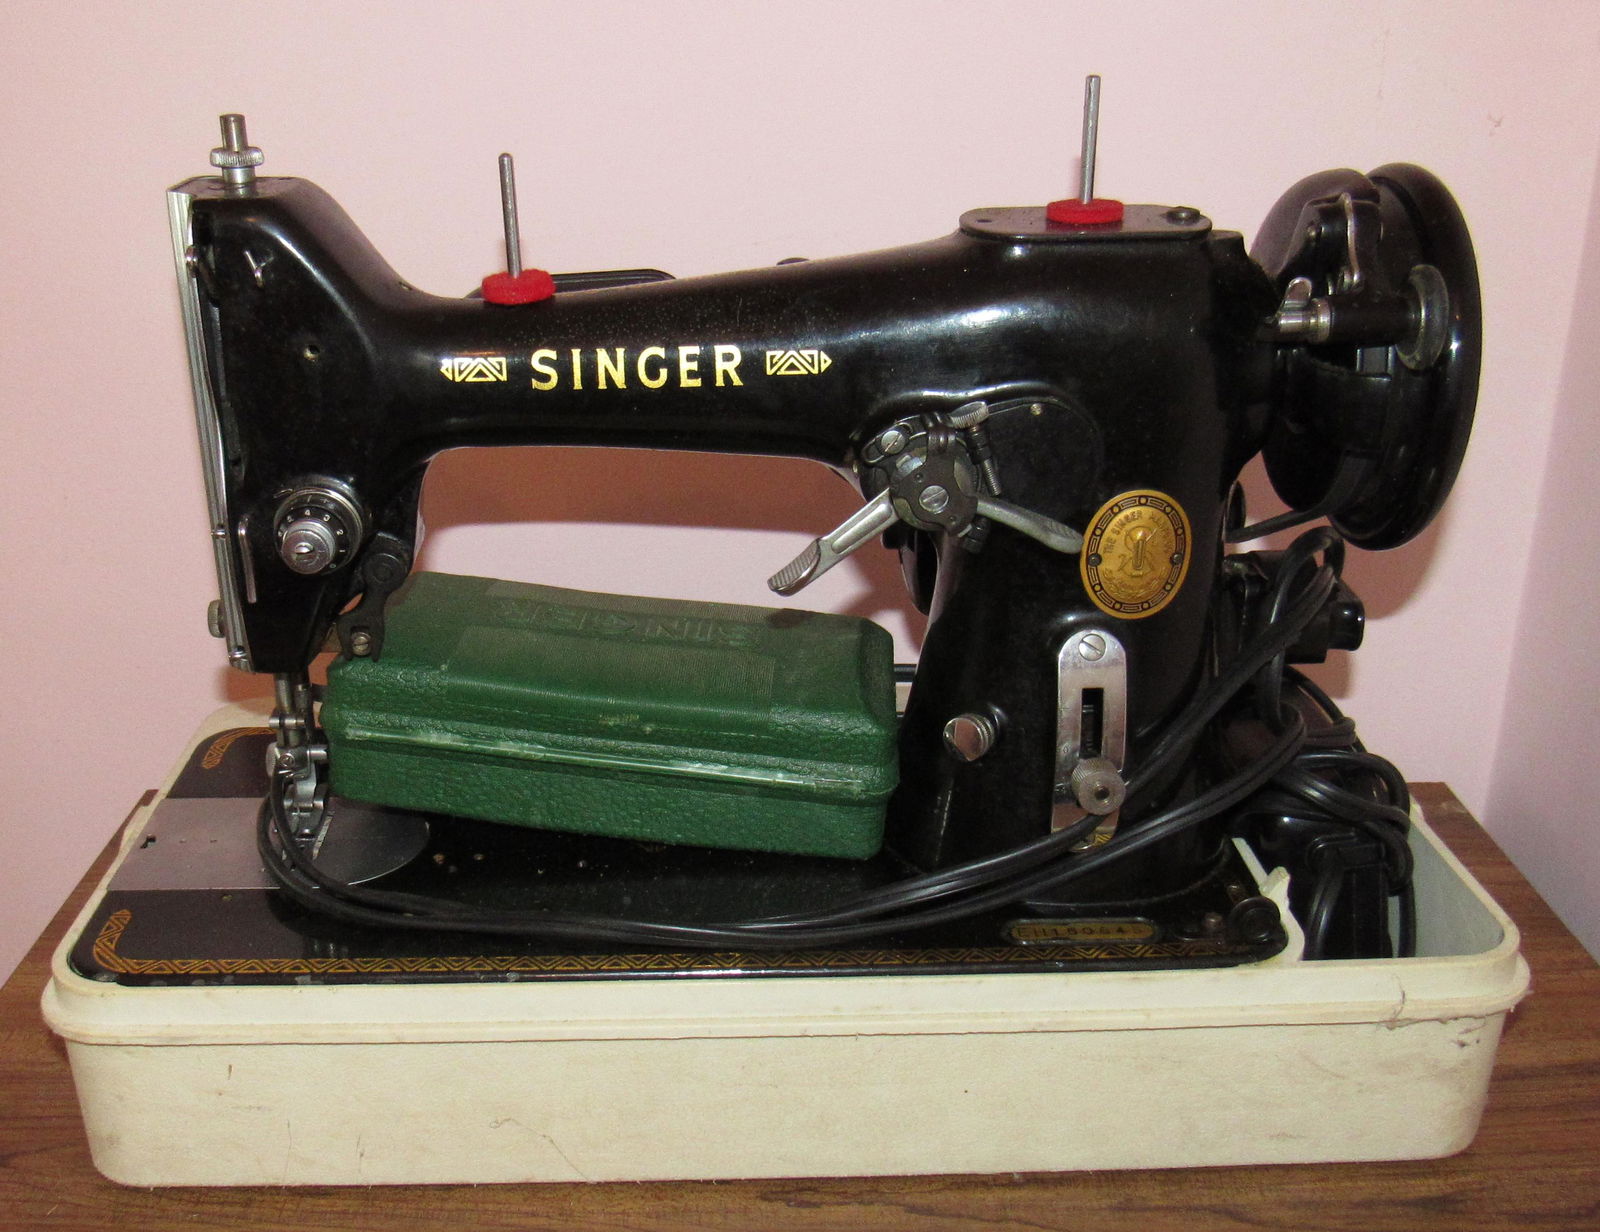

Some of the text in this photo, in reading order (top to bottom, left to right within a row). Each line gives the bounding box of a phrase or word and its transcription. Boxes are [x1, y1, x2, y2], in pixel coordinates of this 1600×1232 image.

[531, 344, 744, 390] SINGER
[323, 514, 331, 522] 3
[497, 599, 757, 648] SINGER
